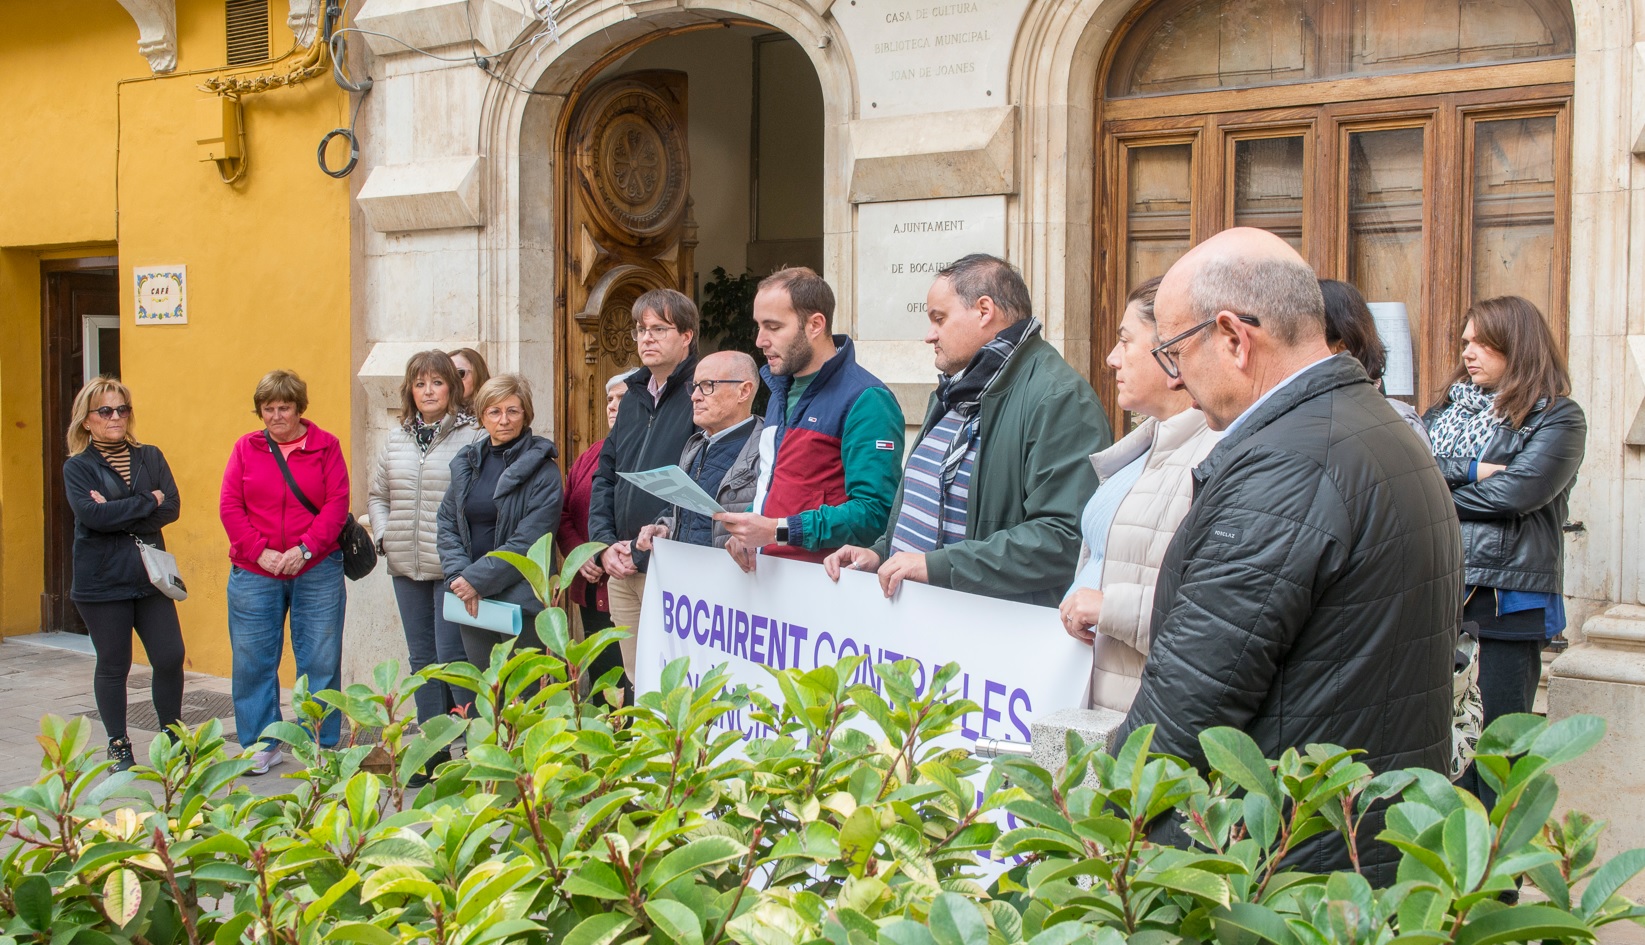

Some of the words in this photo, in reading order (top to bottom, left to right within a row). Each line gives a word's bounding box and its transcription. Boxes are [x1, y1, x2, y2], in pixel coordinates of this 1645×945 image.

[885, 12, 912, 24] CASA
[915, 8, 929, 19] DE
[931, 3, 978, 18] CULTURA
[874, 38, 931, 54] BIBLIOTECA
[935, 30, 990, 46] MUNICIPAL
[888, 69, 916, 82] JOAN
[919, 67, 932, 78] DE
[935, 62, 975, 77] JOANES
[893, 220, 964, 233] AJUNTAMENT
[891, 263, 904, 274] DE
[910, 262, 953, 272] BOCAIRE
[151, 286, 169, 294] CAFÉ
[907, 303, 928, 312] OFIC
[662, 590, 808, 671] BOCAIRENT
